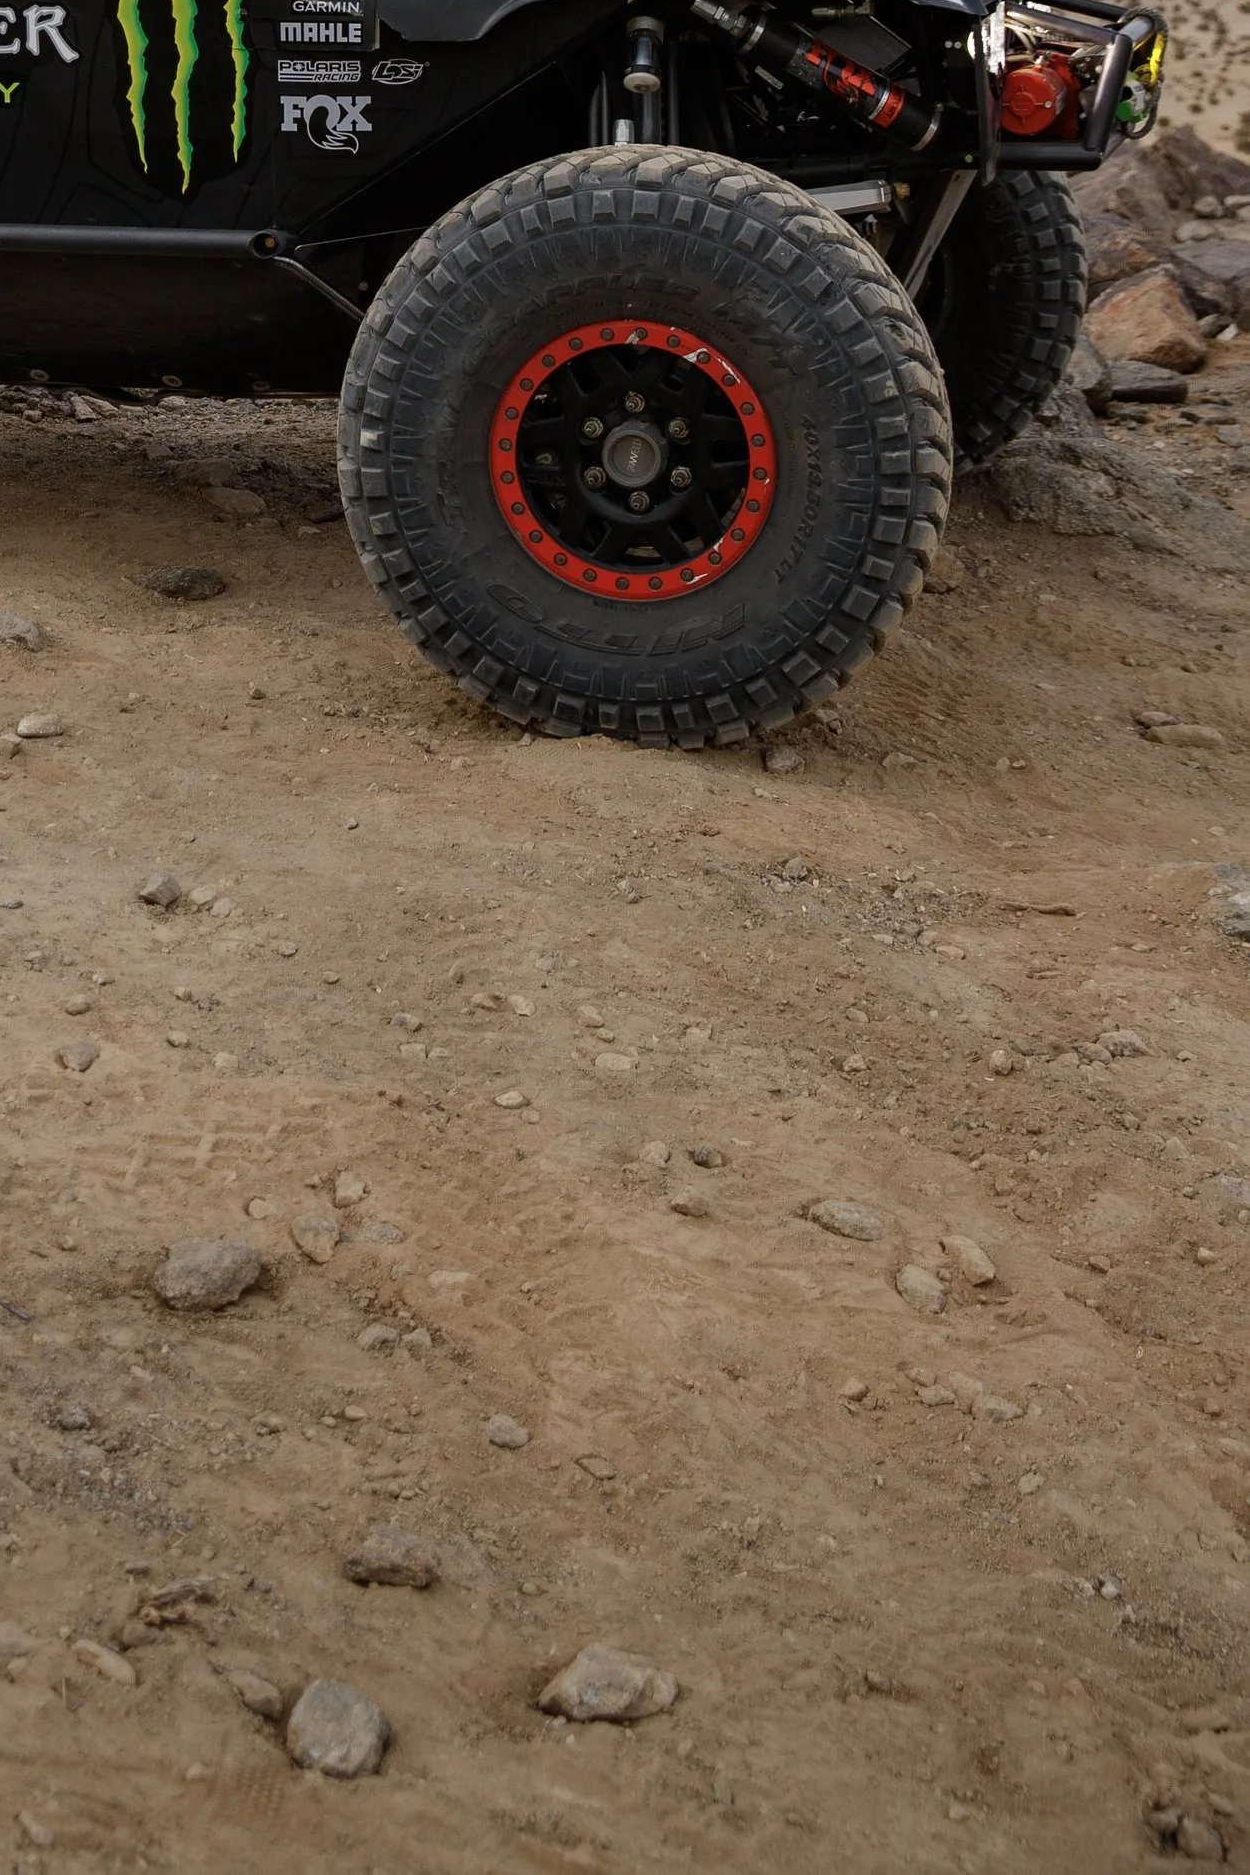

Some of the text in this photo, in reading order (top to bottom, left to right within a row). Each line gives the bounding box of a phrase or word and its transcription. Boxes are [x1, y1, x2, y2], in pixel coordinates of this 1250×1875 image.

[292, 0, 361, 13] GARMIN
[280, 22, 362, 43] MAHLE
[279, 60, 360, 72] POLARIS
[313, 73, 361, 82] RACING
[280, 95, 372, 139] FOX
